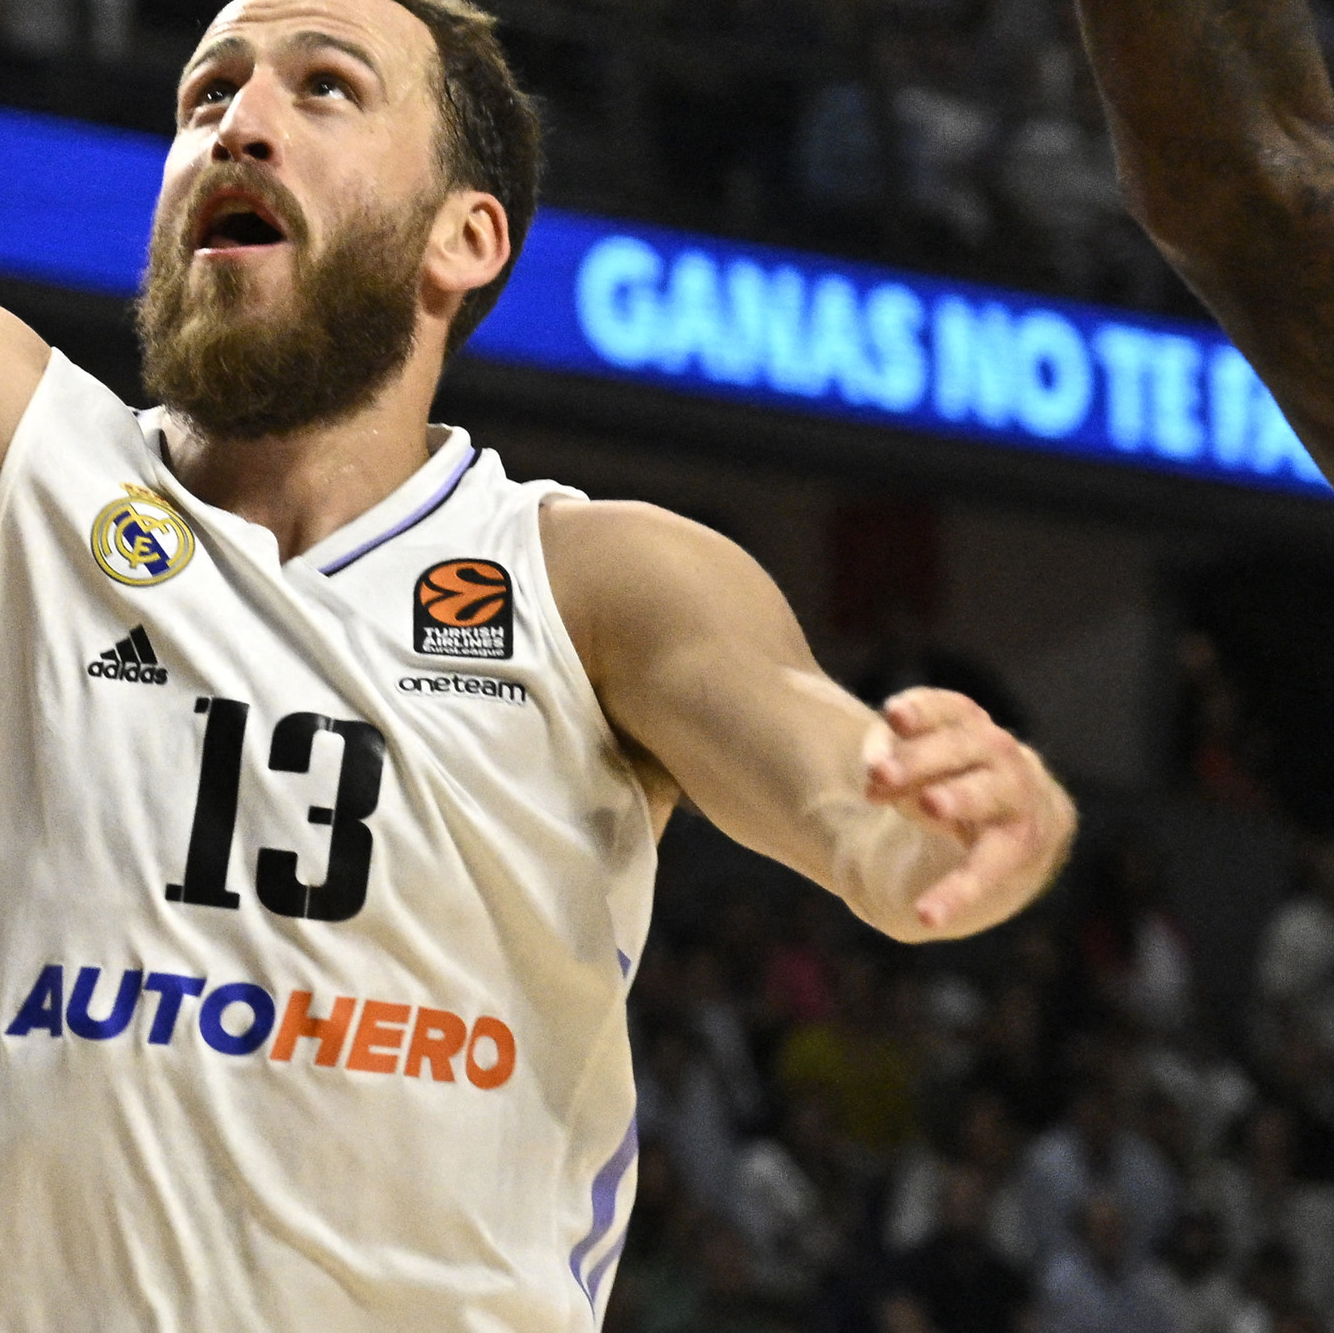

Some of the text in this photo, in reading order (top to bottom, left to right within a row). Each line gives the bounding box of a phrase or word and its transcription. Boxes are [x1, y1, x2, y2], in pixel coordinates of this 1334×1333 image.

[576, 234, 927, 413] GANAS
[931, 293, 1094, 439] NO
[1094, 322, 1207, 460] TE
[423, 626, 505, 638] TURKISH
[423, 636, 505, 649] AIRLINES
[87, 659, 169, 686] adidas
[398, 673, 527, 703] oneteam
[165, 695, 386, 923] 13
[4, 963, 517, 1091] AUTOHERO
